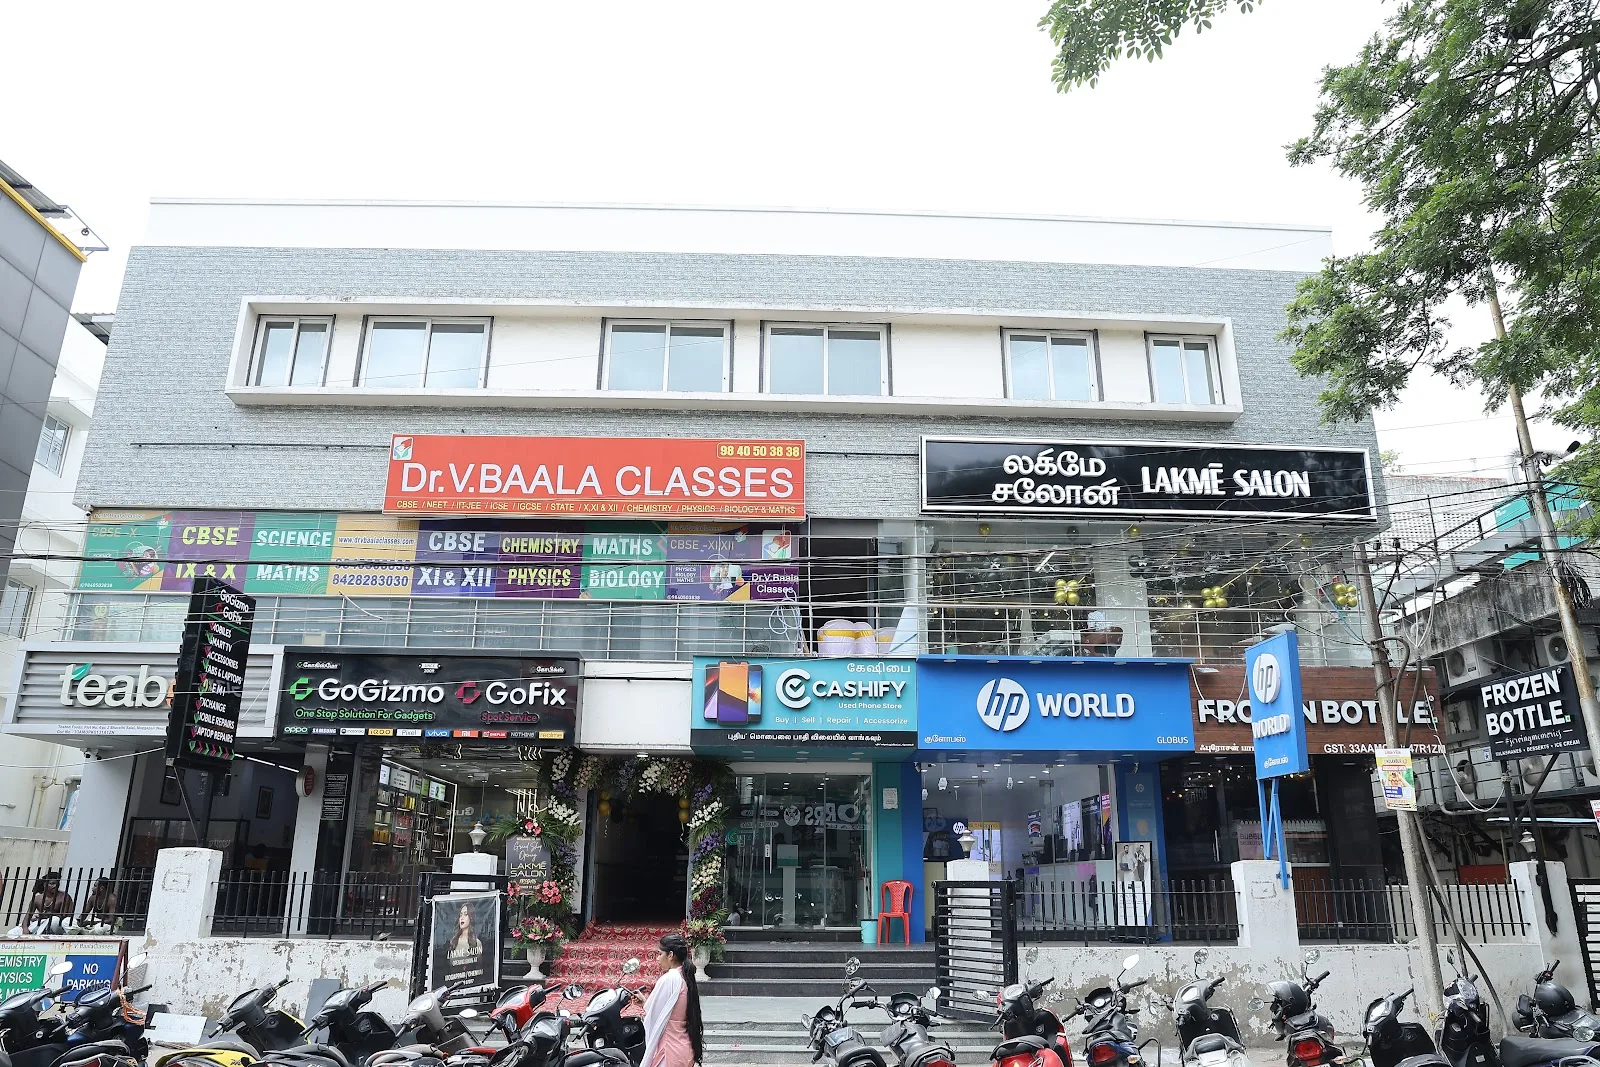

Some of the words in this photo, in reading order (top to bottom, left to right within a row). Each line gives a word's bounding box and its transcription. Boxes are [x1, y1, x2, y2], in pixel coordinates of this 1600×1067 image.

[720, 445, 735, 457] 98
[736, 445, 751, 457] 40
[752, 446, 767, 457] 50
[769, 446, 784, 457] 38
[786, 446, 800, 457] 38
[1002, 448, 1107, 477] லக்மே
[615, 465, 794, 498] CLASSES
[1233, 469, 1311, 498] SALON
[991, 477, 1121, 506] சலோன்
[396, 500, 418, 509] CBSE
[427, 501, 448, 509] NEET
[517, 503, 542, 511] IGCSE
[550, 503, 575, 511] STATE
[600, 504, 606, 512] &
[608, 504, 618, 512] XII
[627, 504, 673, 513] CHEMISTRY
[681, 505, 716, 513] PHYSICS
[724, 505, 759, 514] BIOLOGY
[768, 506, 796, 514] MATHS
[182, 526, 239, 546] CBSE
[256, 529, 333, 547] SCIENCE
[428, 532, 486, 552] CBSE
[670, 539, 699, 550] CBSE
[502, 537, 580, 554] CHEMISTRY
[592, 537, 653, 556] MATHS
[256, 564, 320, 582] MATHS
[332, 574, 409, 588] 8428283030
[417, 566, 441, 586] XI
[443, 571, 456, 586] &
[461, 567, 492, 587] XII
[507, 568, 571, 587] PHYSICS
[589, 569, 664, 588] BIOLOGY
[318, 677, 445, 704] GoGizmo
[485, 681, 567, 706] GoFix
[812, 680, 907, 699] CASHIFY
[1481, 670, 1561, 708] FROZEN
[838, 702, 857, 710] Used
[858, 702, 882, 710] Phone
[1036, 692, 1135, 718] WORLD
[1197, 699, 1318, 724] FRON
[296, 708, 315, 719] One
[316, 709, 338, 721] Stop
[339, 709, 376, 720] Solution
[378, 710, 393, 720] For
[394, 711, 434, 723] Gadgets
[481, 712, 502, 724] Spot
[503, 713, 538, 722] Service
[775, 716, 790, 725] Buy
[801, 716, 816, 724] Sell
[826, 717, 852, 726] Repair
[863, 717, 908, 725] Accessorize
[283, 726, 308, 735] oppo
[1251, 713, 1290, 739] WORLD
[1156, 736, 1189, 744] GLOBUS
[1324, 743, 1347, 754] GST:
[1526, 744, 1549, 752] DESSERTS
[1563, 739, 1581, 747] CREAM
[510, 869, 547, 878] SALON
[83, 963, 99, 975] NO
